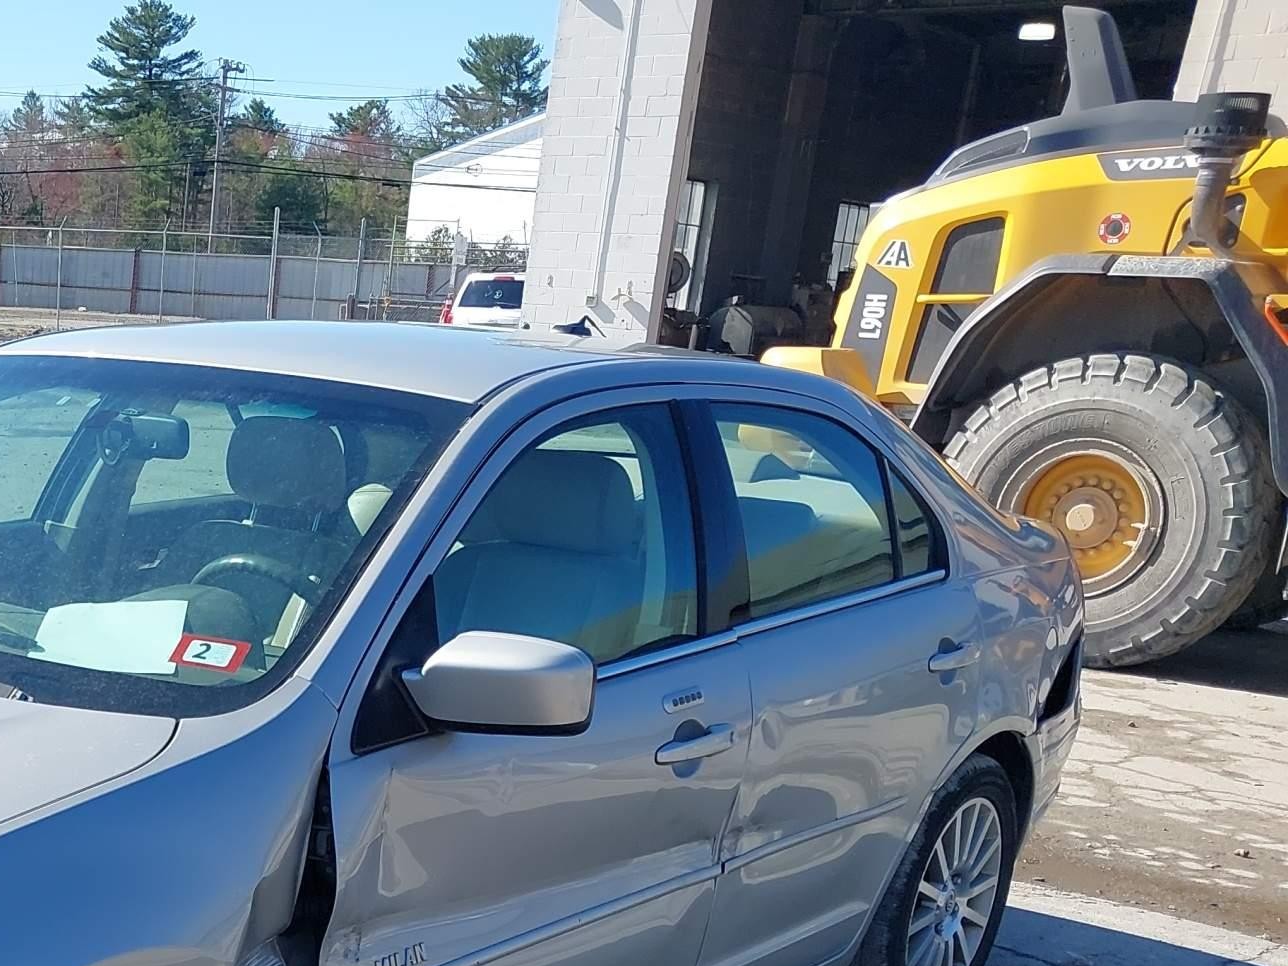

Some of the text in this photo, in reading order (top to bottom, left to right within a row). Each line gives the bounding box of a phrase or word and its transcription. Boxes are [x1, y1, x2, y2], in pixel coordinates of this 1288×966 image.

[1114, 153, 1202, 173] VOLV
[858, 293, 889, 339] L90H
[191, 643, 212, 660] 2
